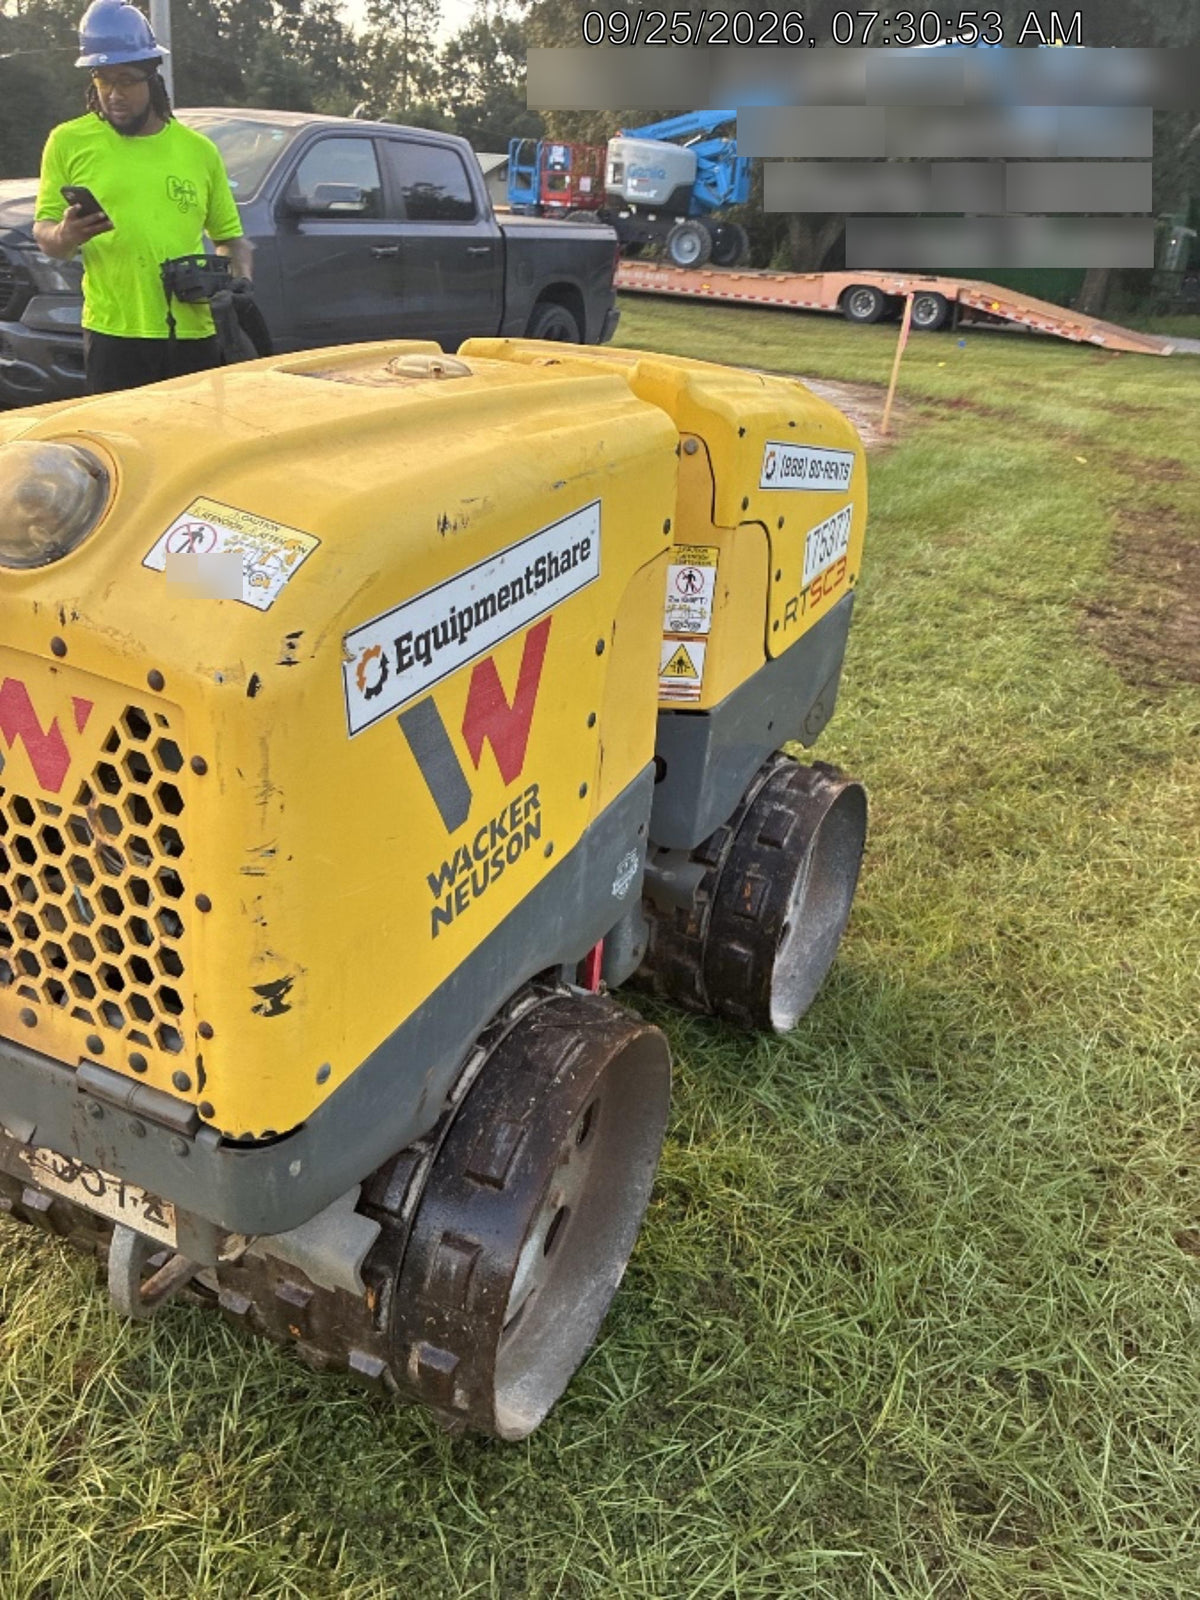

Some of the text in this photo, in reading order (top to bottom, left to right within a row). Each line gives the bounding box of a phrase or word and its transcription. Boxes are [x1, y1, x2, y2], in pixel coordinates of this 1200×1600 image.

[779, 454, 850, 482] (888) 80-RENTS
[805, 507, 851, 575] 175372
[393, 536, 591, 676] EquipmentShare
[426, 783, 540, 900] WACKER
[430, 810, 541, 940] NEUSON
